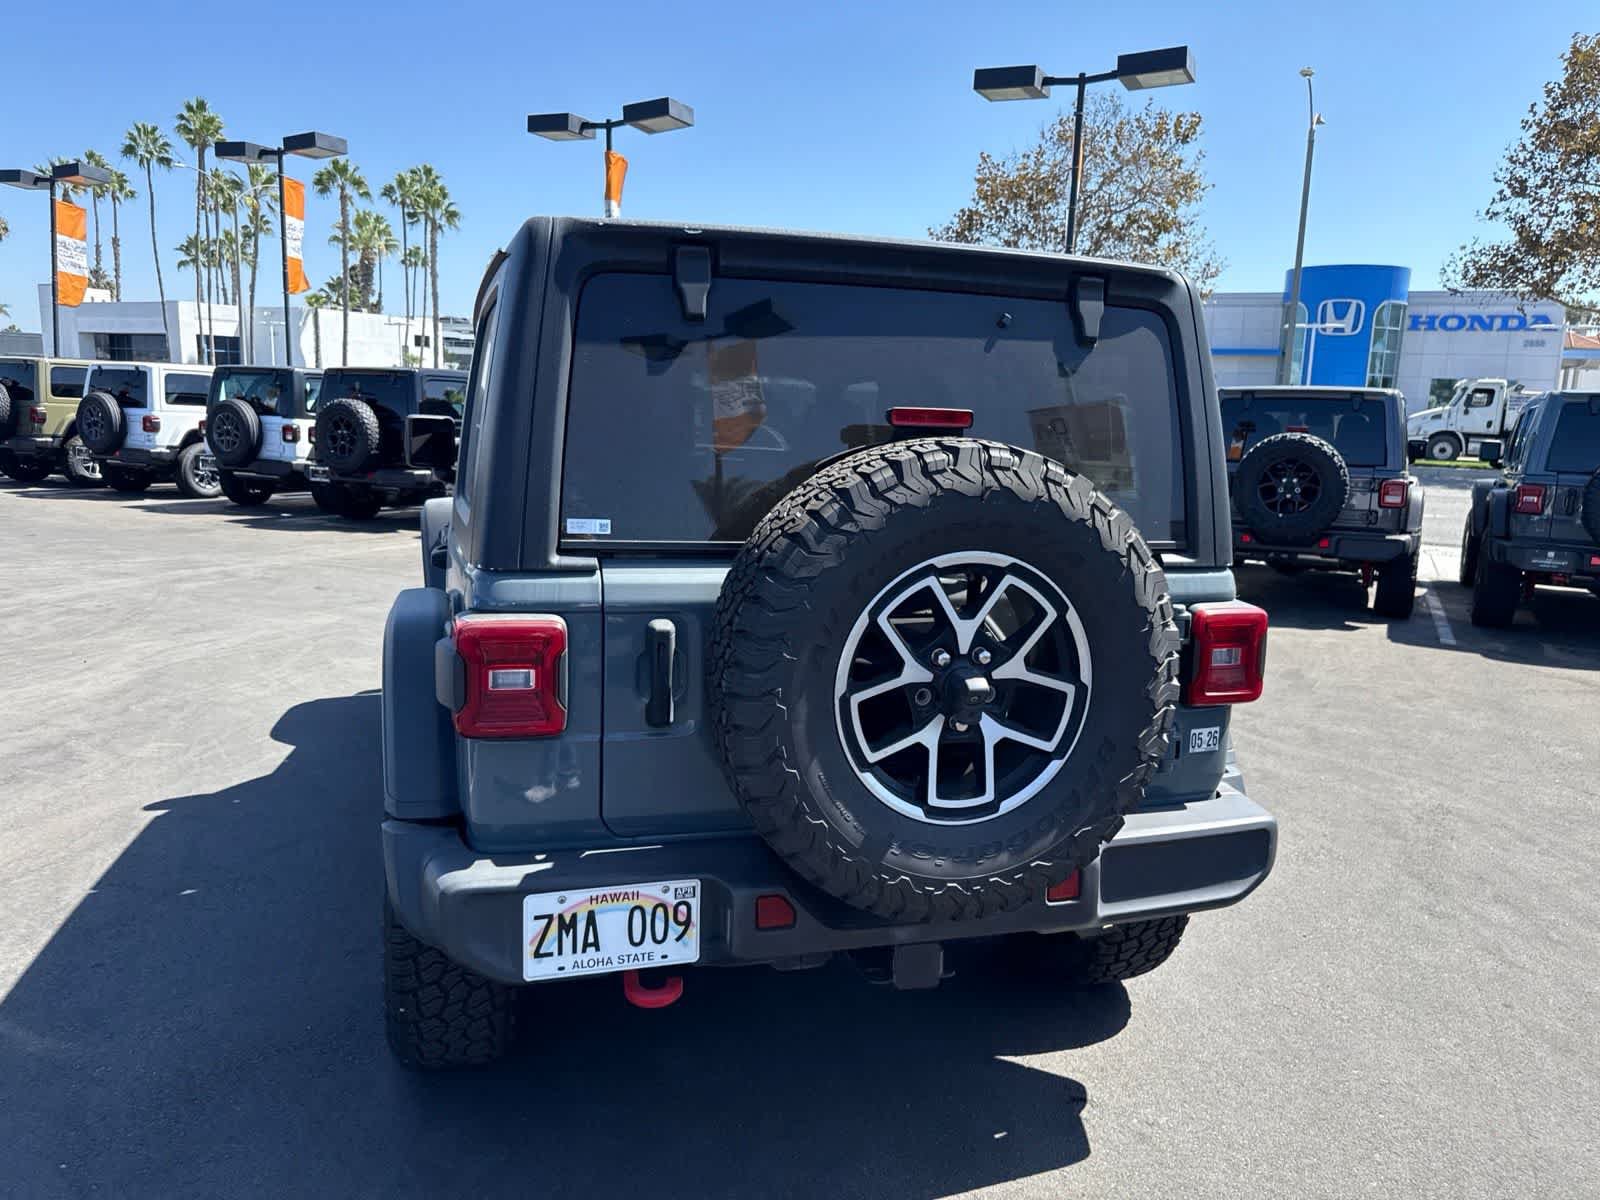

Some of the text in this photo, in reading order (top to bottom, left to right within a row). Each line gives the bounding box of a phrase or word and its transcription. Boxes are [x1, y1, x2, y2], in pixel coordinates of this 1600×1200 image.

[1407, 313, 1558, 332] HONDA
[1192, 731, 1218, 748] 05 26
[590, 890, 640, 905] HAWAII
[534, 901, 692, 959] ZMA 009
[572, 951, 655, 970] ALOHA STATE
